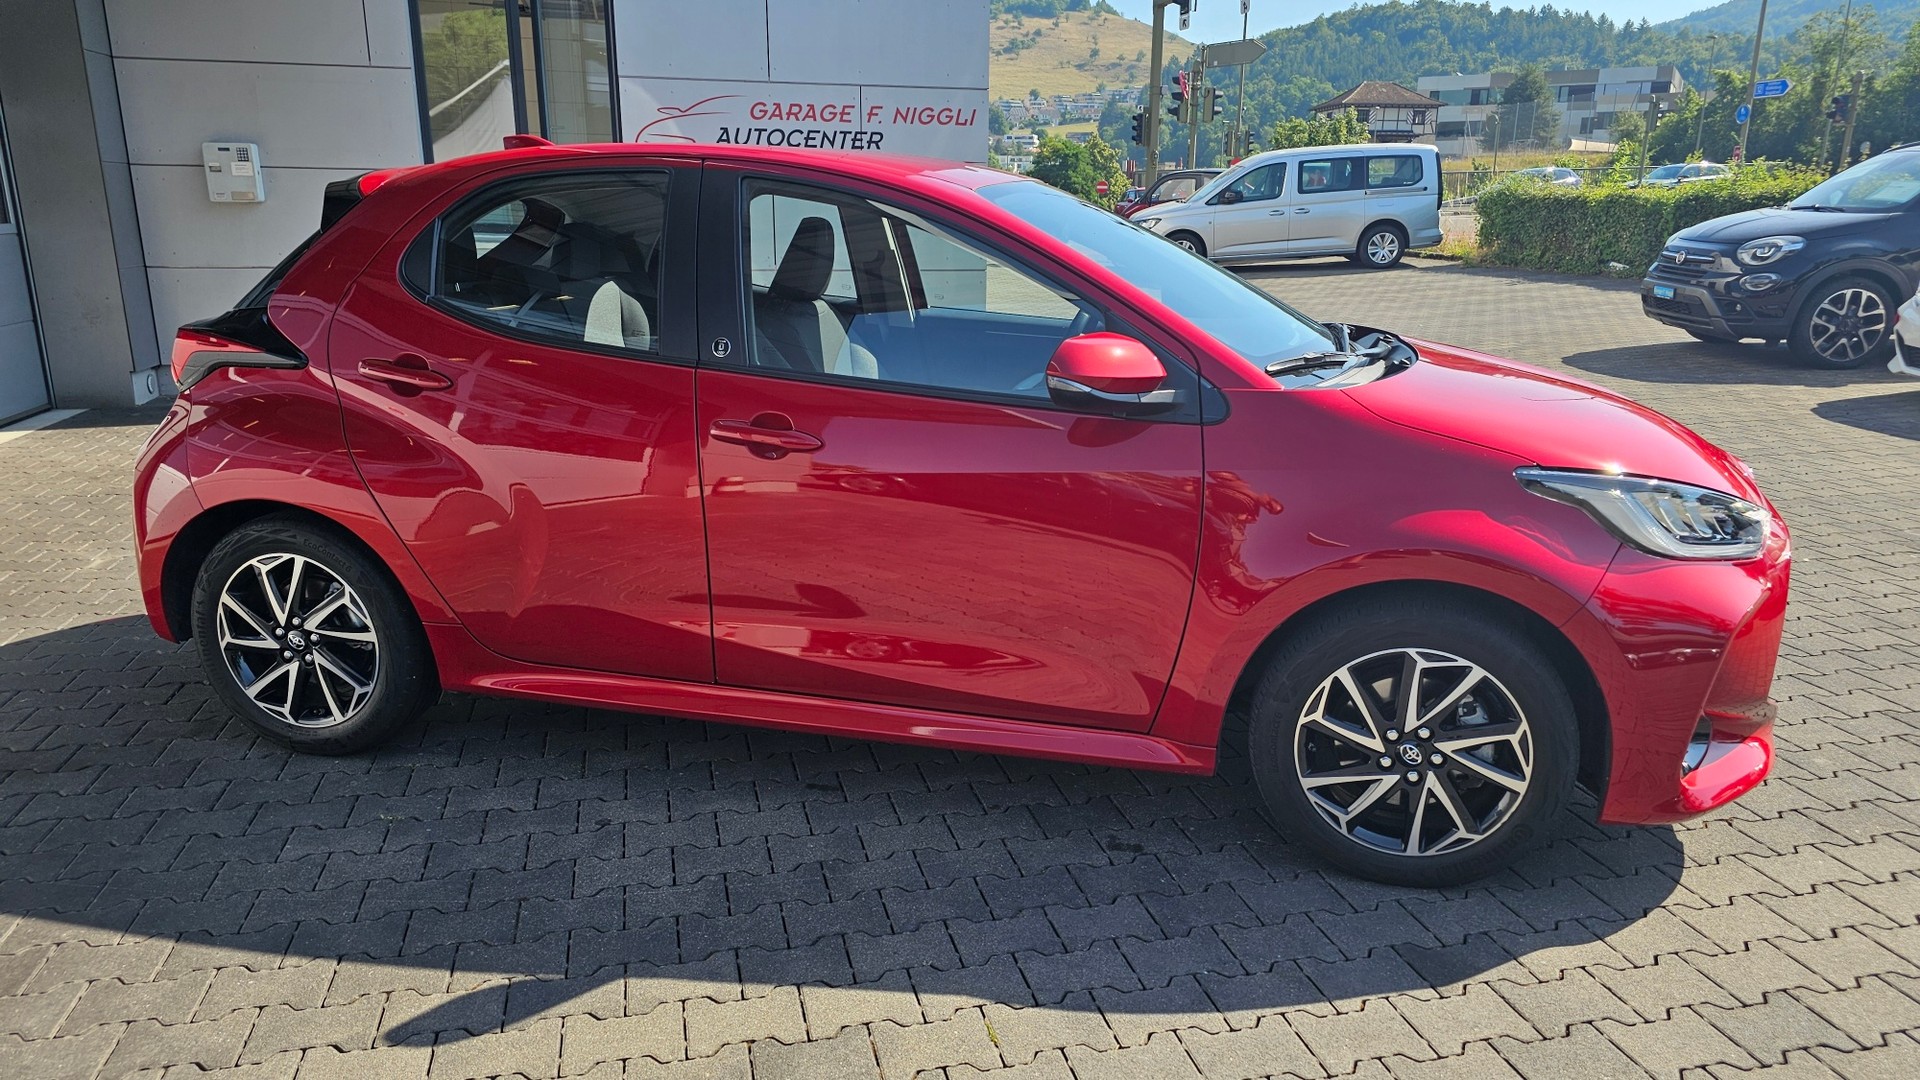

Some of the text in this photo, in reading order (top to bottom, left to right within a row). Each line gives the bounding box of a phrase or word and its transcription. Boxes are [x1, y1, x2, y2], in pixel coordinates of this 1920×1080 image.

[749, 102, 977, 127] GARAGE F. NIGGLI
[716, 127, 884, 150] AUTOCENTER
[303, 538, 346, 569] EcoContact
